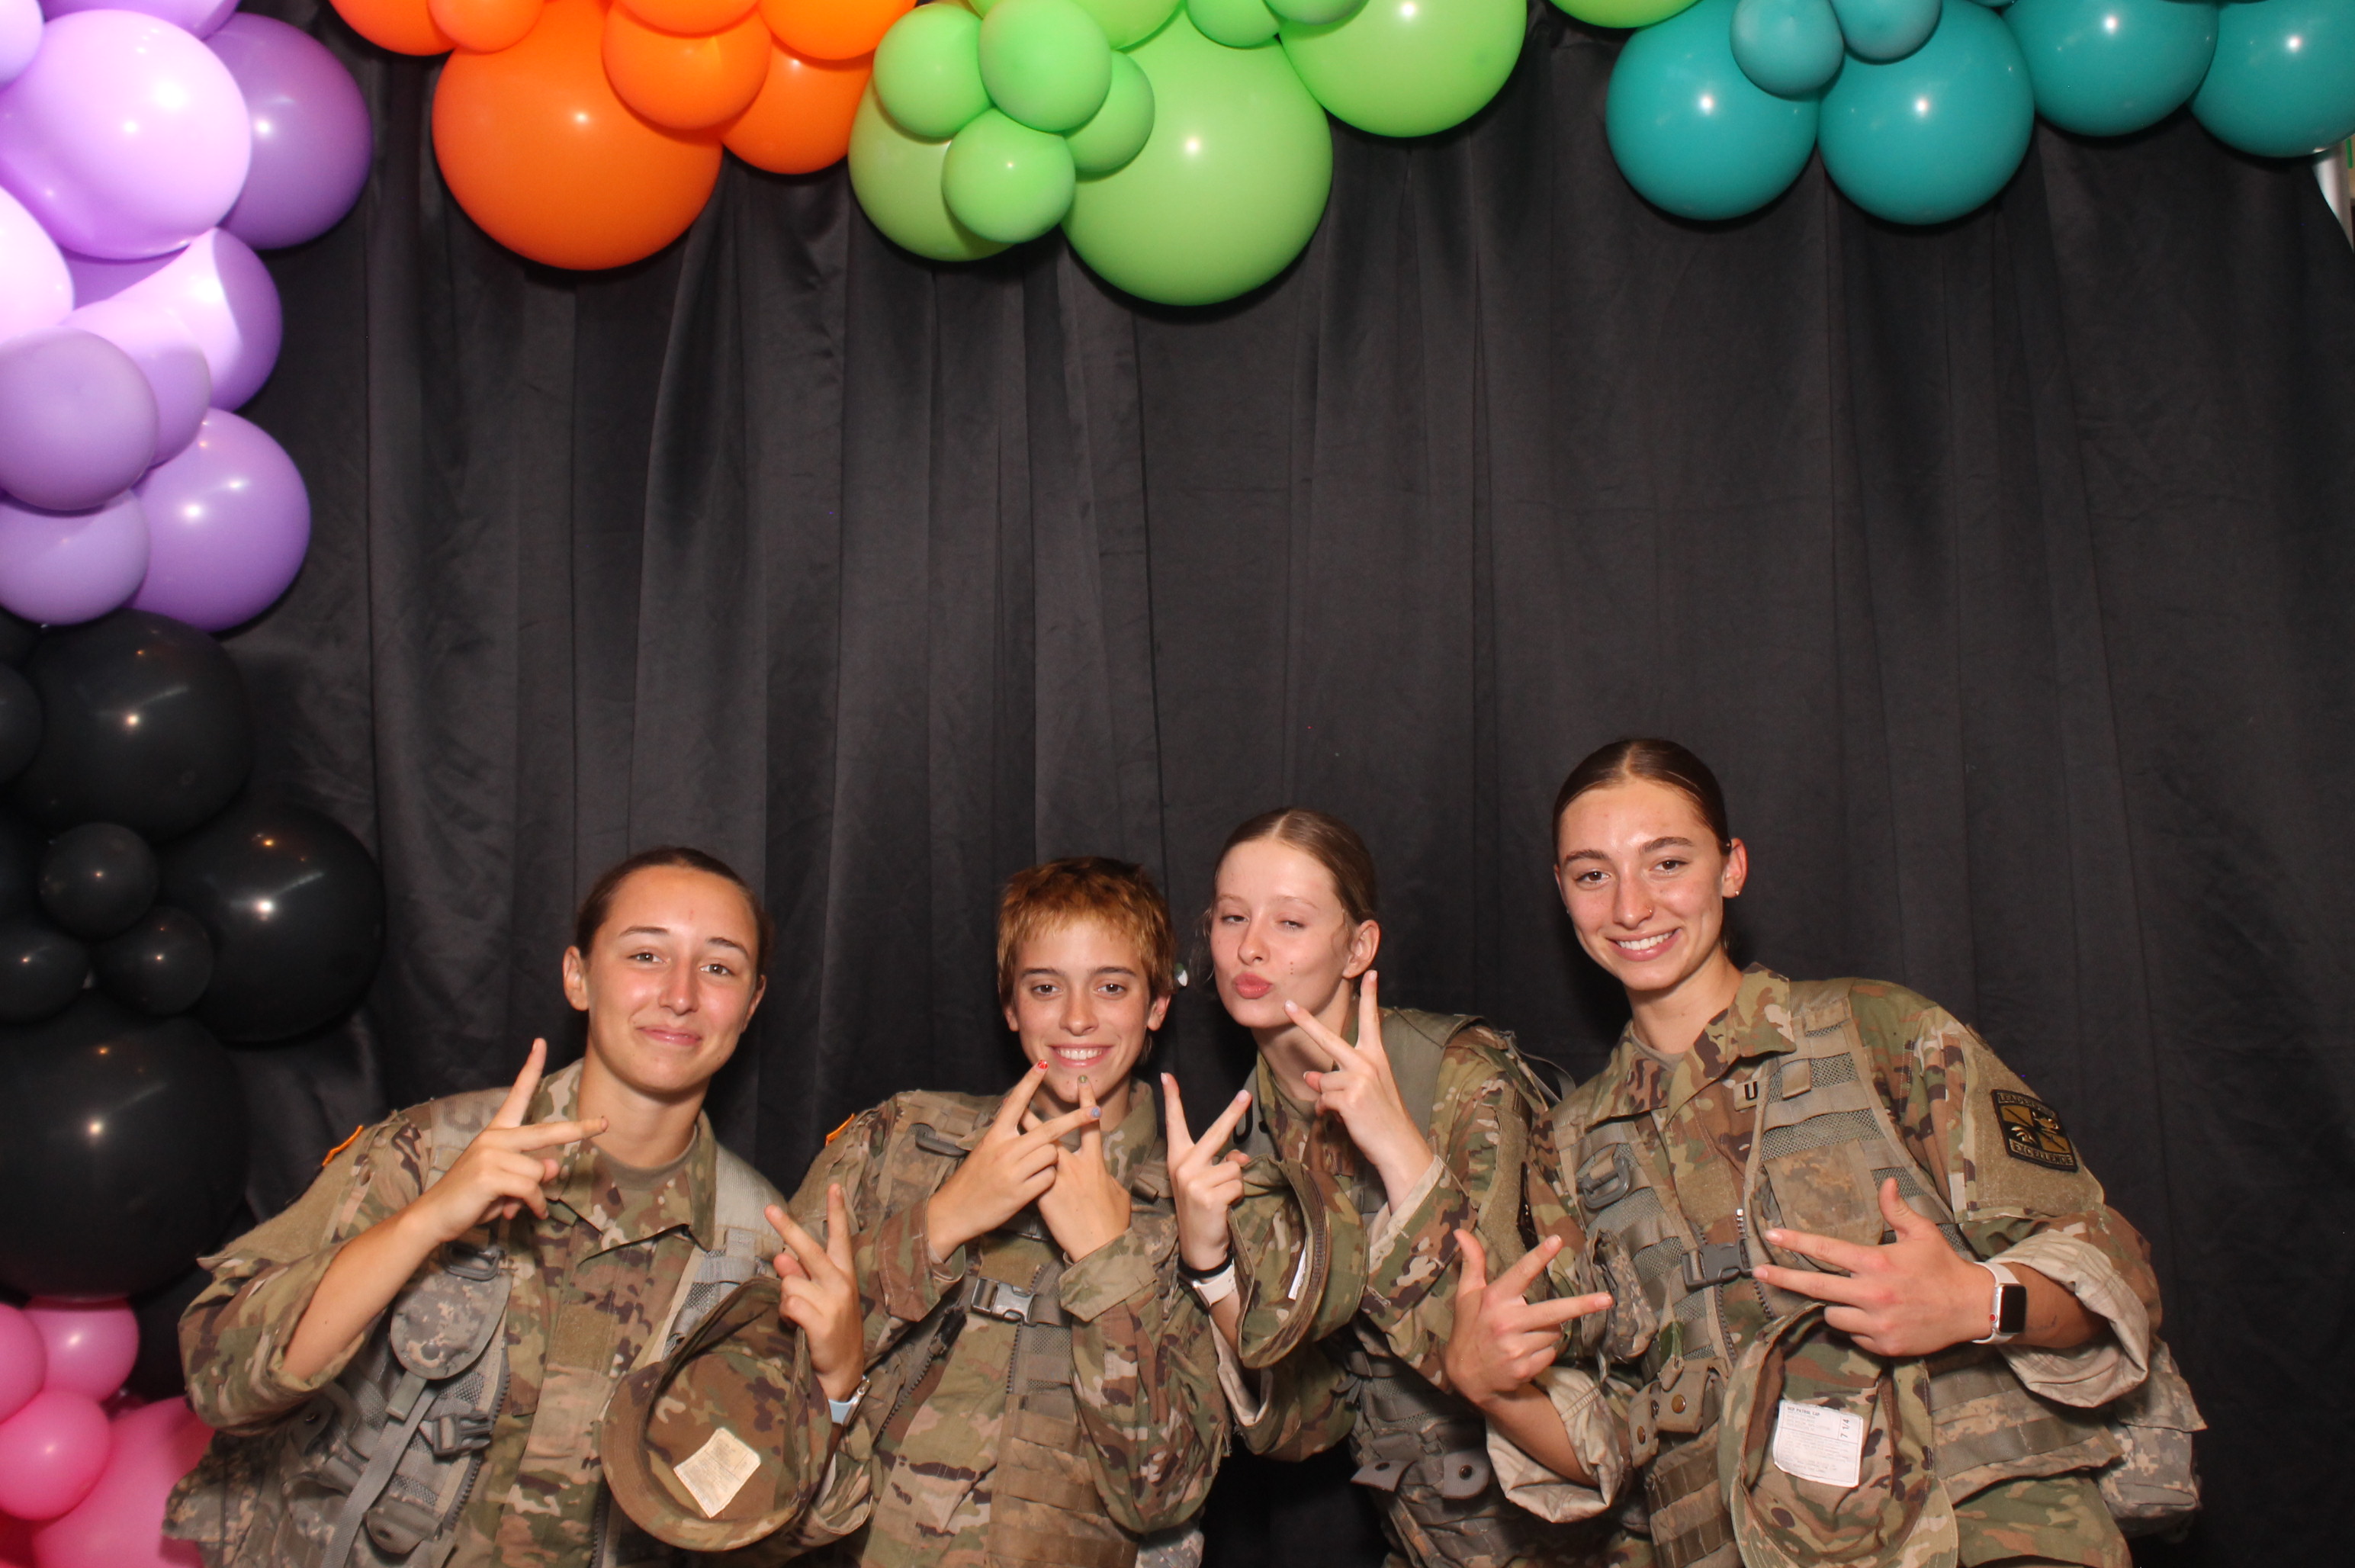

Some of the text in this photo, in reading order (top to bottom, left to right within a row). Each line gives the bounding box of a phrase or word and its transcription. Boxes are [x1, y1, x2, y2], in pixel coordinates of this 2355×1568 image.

[1999, 1094, 2057, 1119] LEADER
[2013, 1142, 2072, 1164] EXCELLENCE
[1842, 1419, 1850, 1430] 1/4
